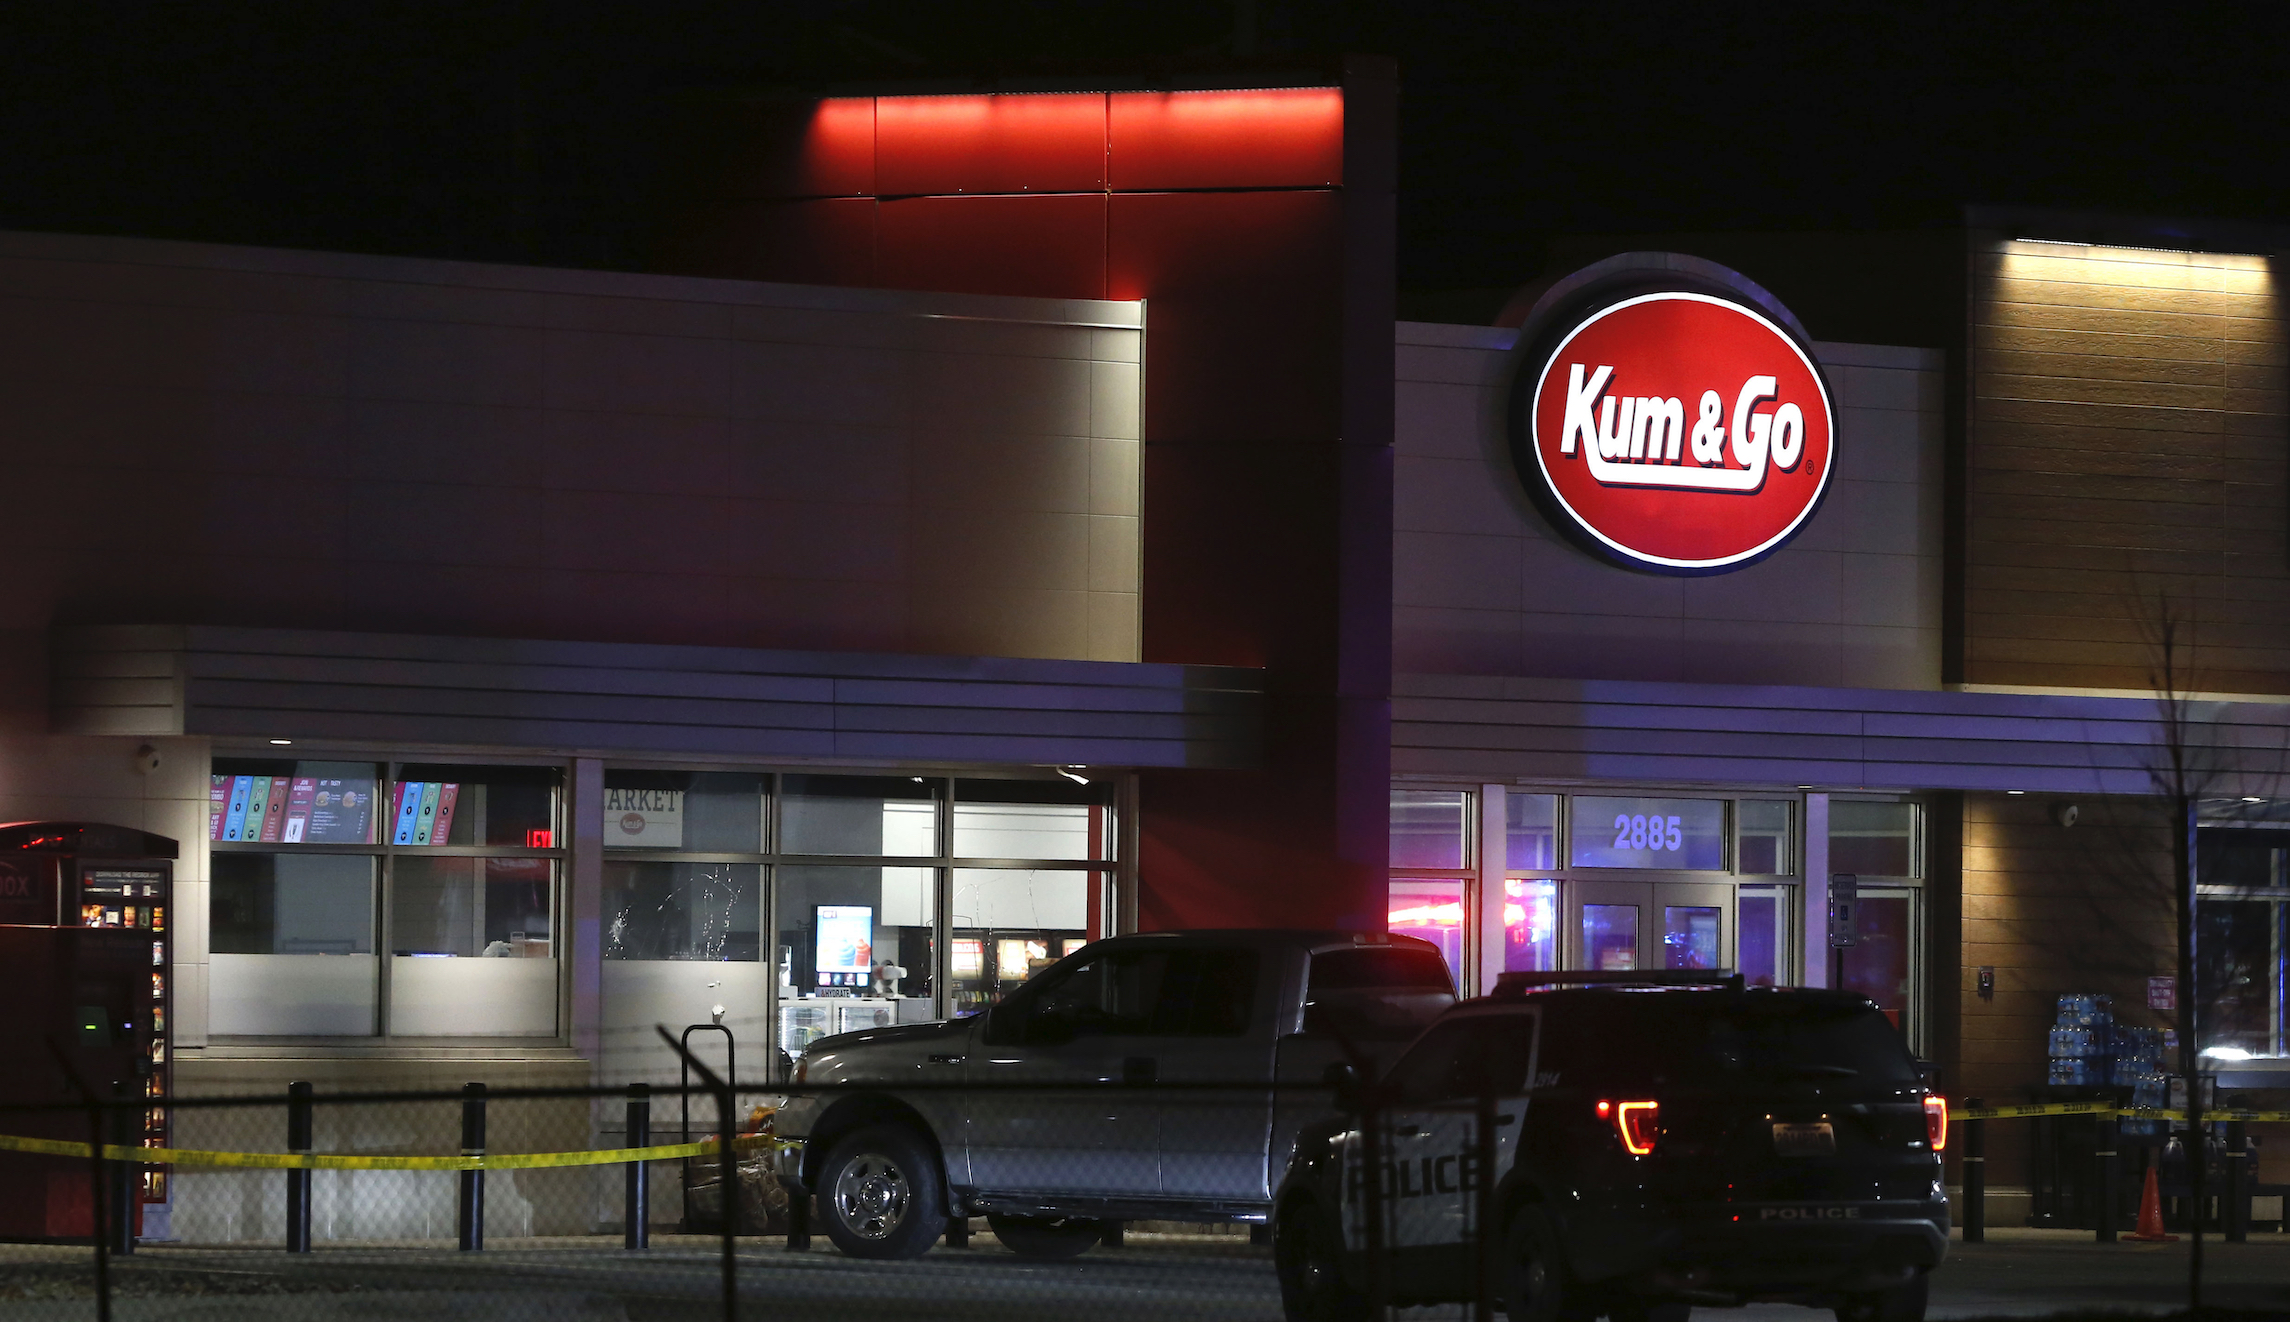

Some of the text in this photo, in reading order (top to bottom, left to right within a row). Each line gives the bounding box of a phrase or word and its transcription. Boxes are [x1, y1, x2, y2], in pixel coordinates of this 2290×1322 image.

[1560, 363, 1804, 470] Kum & Go
[604, 789, 679, 812] ARKET
[1613, 814, 1682, 851] 2885
[0, 875, 30, 898] OX
[1347, 1152, 1481, 1203] POLICE
[1760, 1207, 1860, 1220] POLICE
